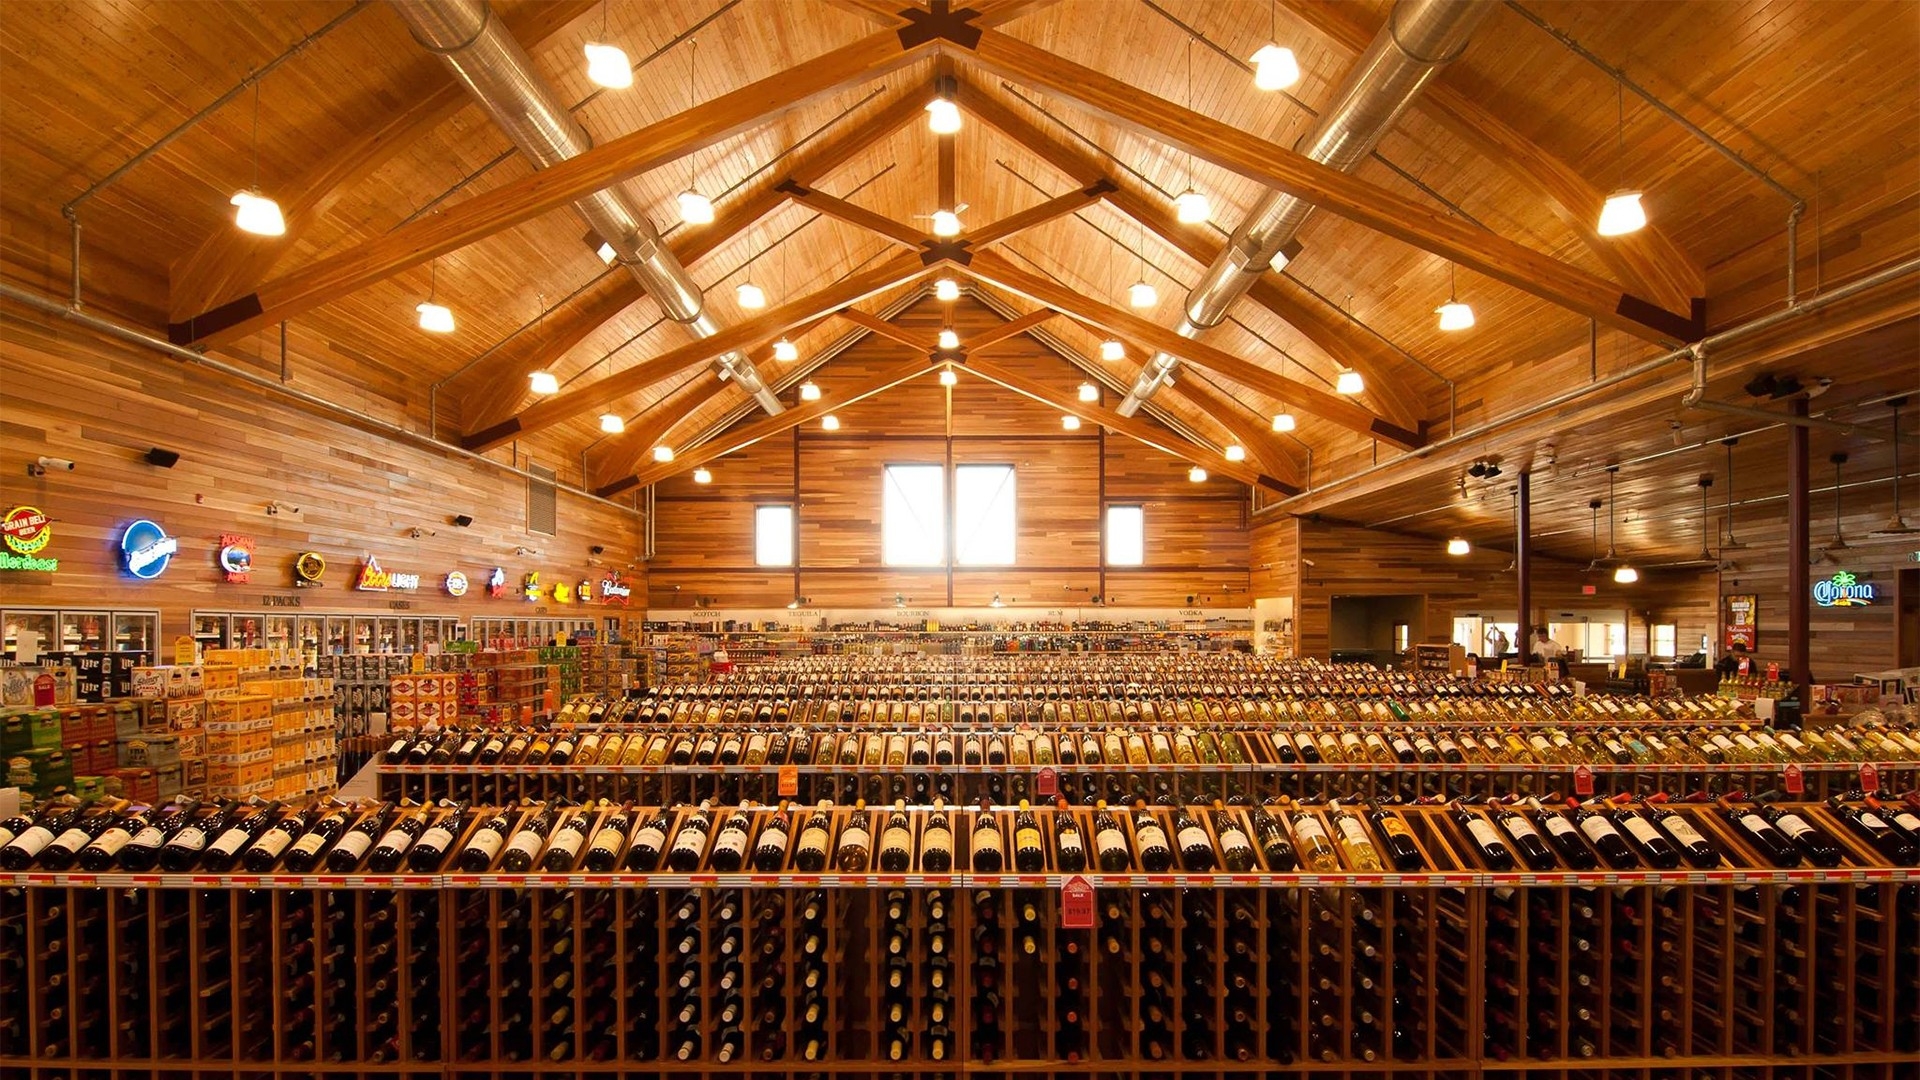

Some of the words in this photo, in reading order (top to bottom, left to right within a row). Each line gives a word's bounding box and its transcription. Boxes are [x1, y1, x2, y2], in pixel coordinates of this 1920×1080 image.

[4, 518, 29, 531] GRAIN
[28, 514, 47, 526] BELT
[18, 526, 36, 536] BEER
[1814, 580, 1873, 606] Corona
[81, 659, 100, 670] Lite
[81, 682, 100, 693] Lite
